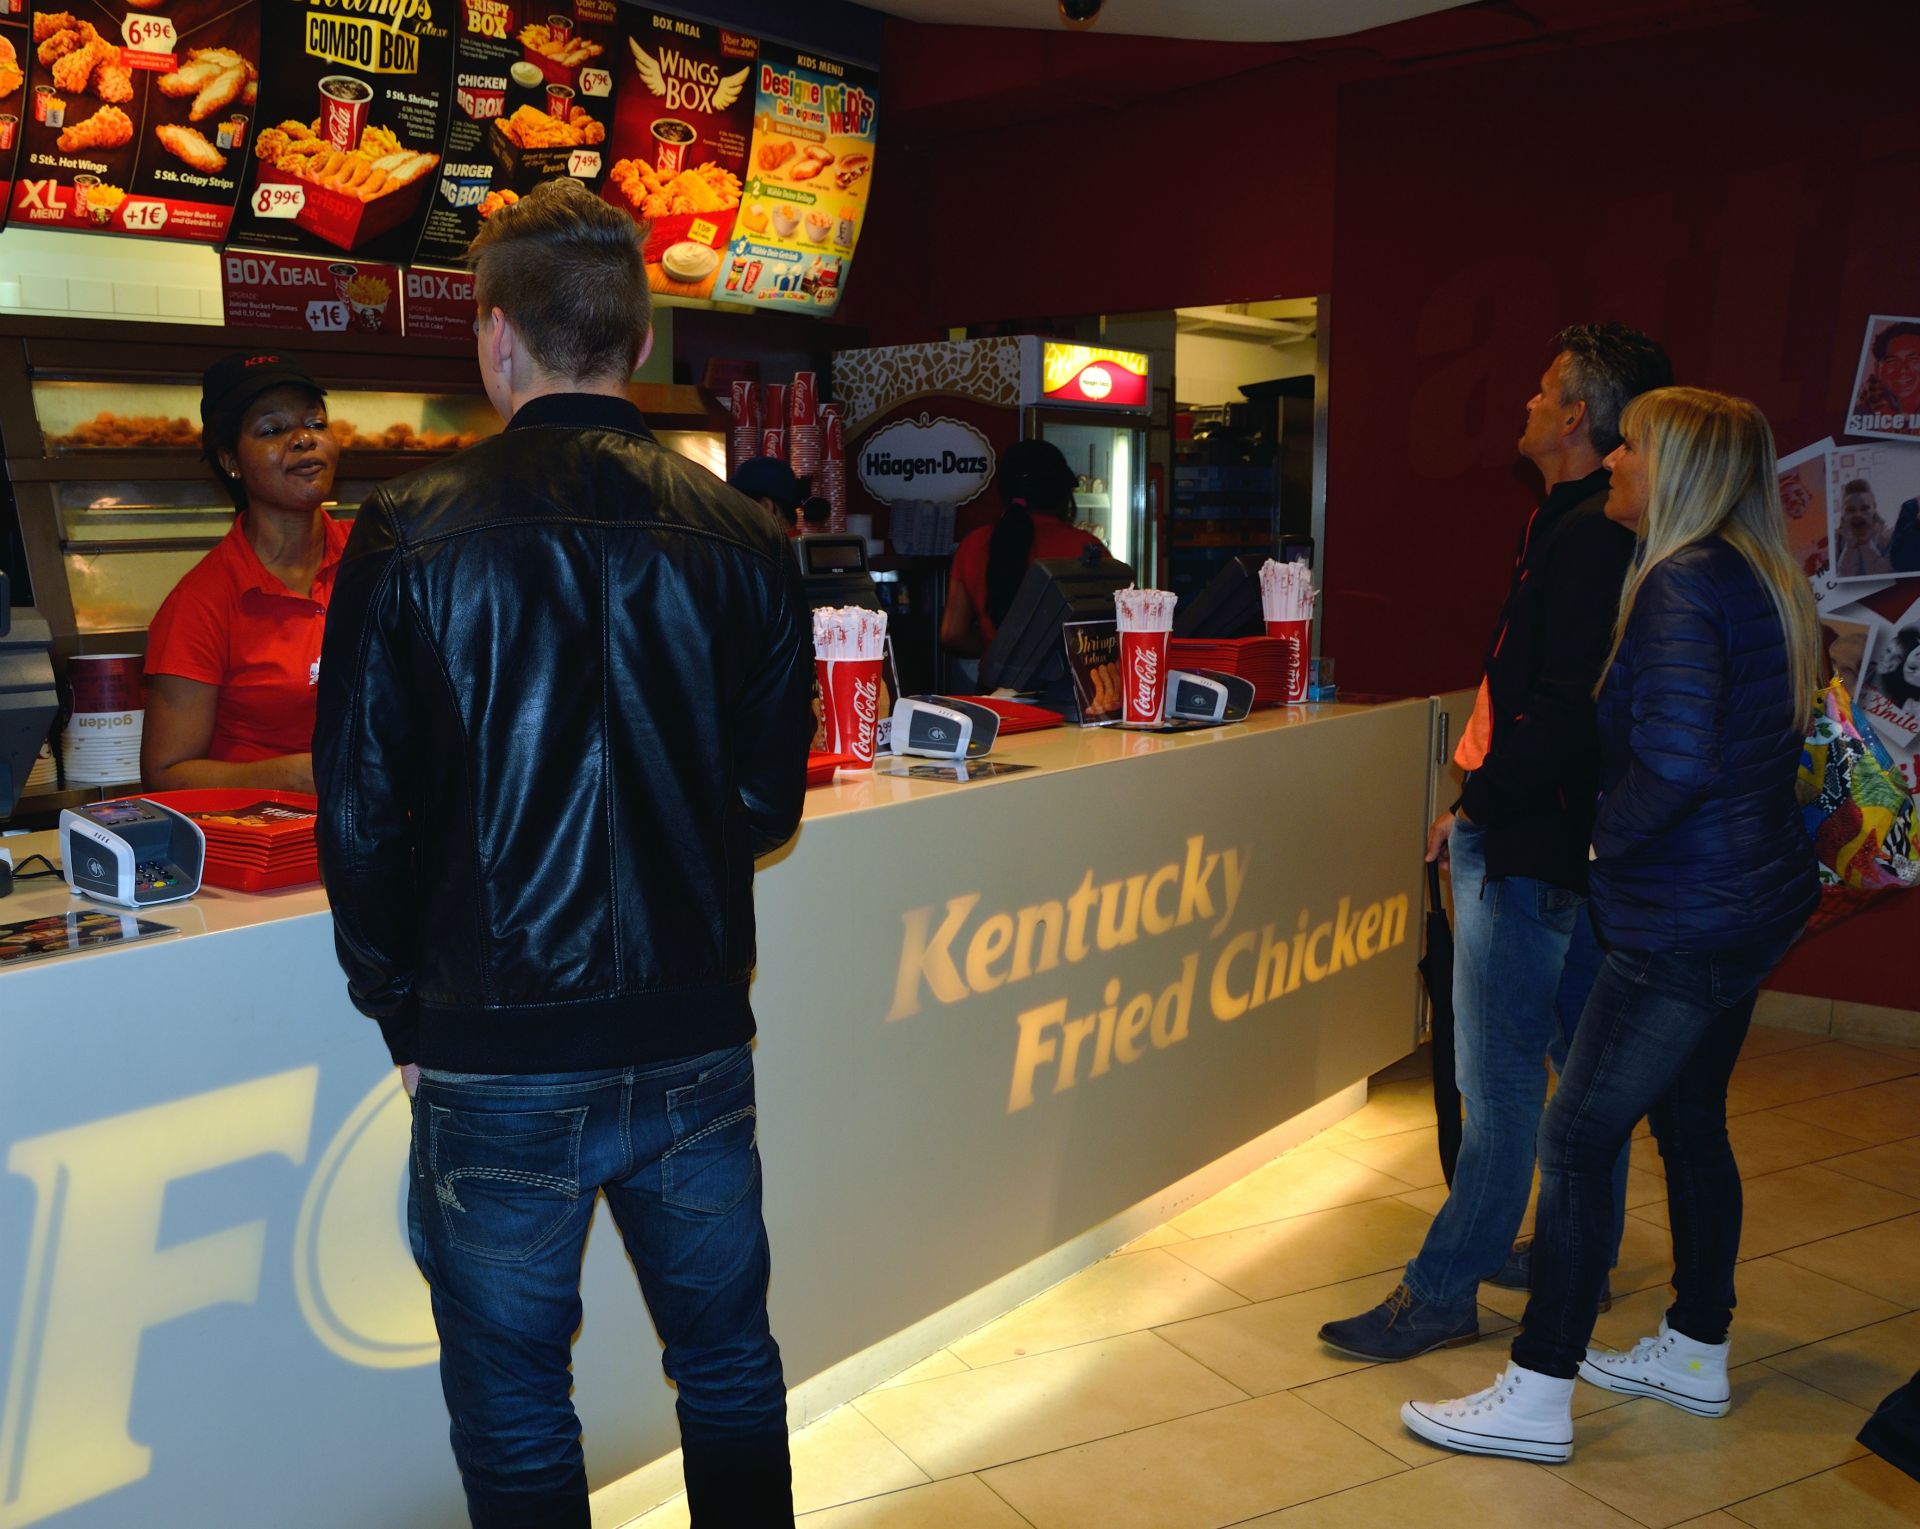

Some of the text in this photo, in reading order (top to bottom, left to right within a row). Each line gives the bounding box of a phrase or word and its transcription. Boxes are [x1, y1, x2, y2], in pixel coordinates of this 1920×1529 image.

[467, 10, 508, 40] BOX
[652, 15, 701, 39] BOX MEAL
[309, 17, 373, 67] COMBO
[378, 27, 416, 71] BOX
[796, 54, 844, 77] KIDS MENU
[457, 73, 508, 91] CHICKEN
[408, 93, 439, 109] Shrimps
[457, 88, 505, 119] BIG BOX
[665, 77, 713, 114] BOX
[30, 154, 108, 174] 8 Stk. Hot Wings
[443, 163, 494, 179] BURGER
[154, 170, 234, 190] 5 Stk. Crispy Strips
[752, 180, 761, 197] 2
[18, 178, 68, 209] XL
[257, 188, 301, 212] 8,99€
[439, 178, 490, 208] BIG BOX
[29, 208, 65, 220] MENU
[126, 206, 162, 226] +1€
[735, 240, 746, 254] 3
[226, 257, 328, 287] BOX DEAL
[406, 273, 452, 300] BOX
[309, 304, 343, 328] +1€
[244, 355, 281, 367] KFC
[1850, 411, 1905, 433] spice
[866, 450, 988, 482] Häagen-Dazs
[1076, 628, 1119, 655] Shrimp
[79, 713, 133, 730] golden
[884, 833, 1253, 1026] Kentucky
[1006, 892, 1410, 1116] Fried Chicken
